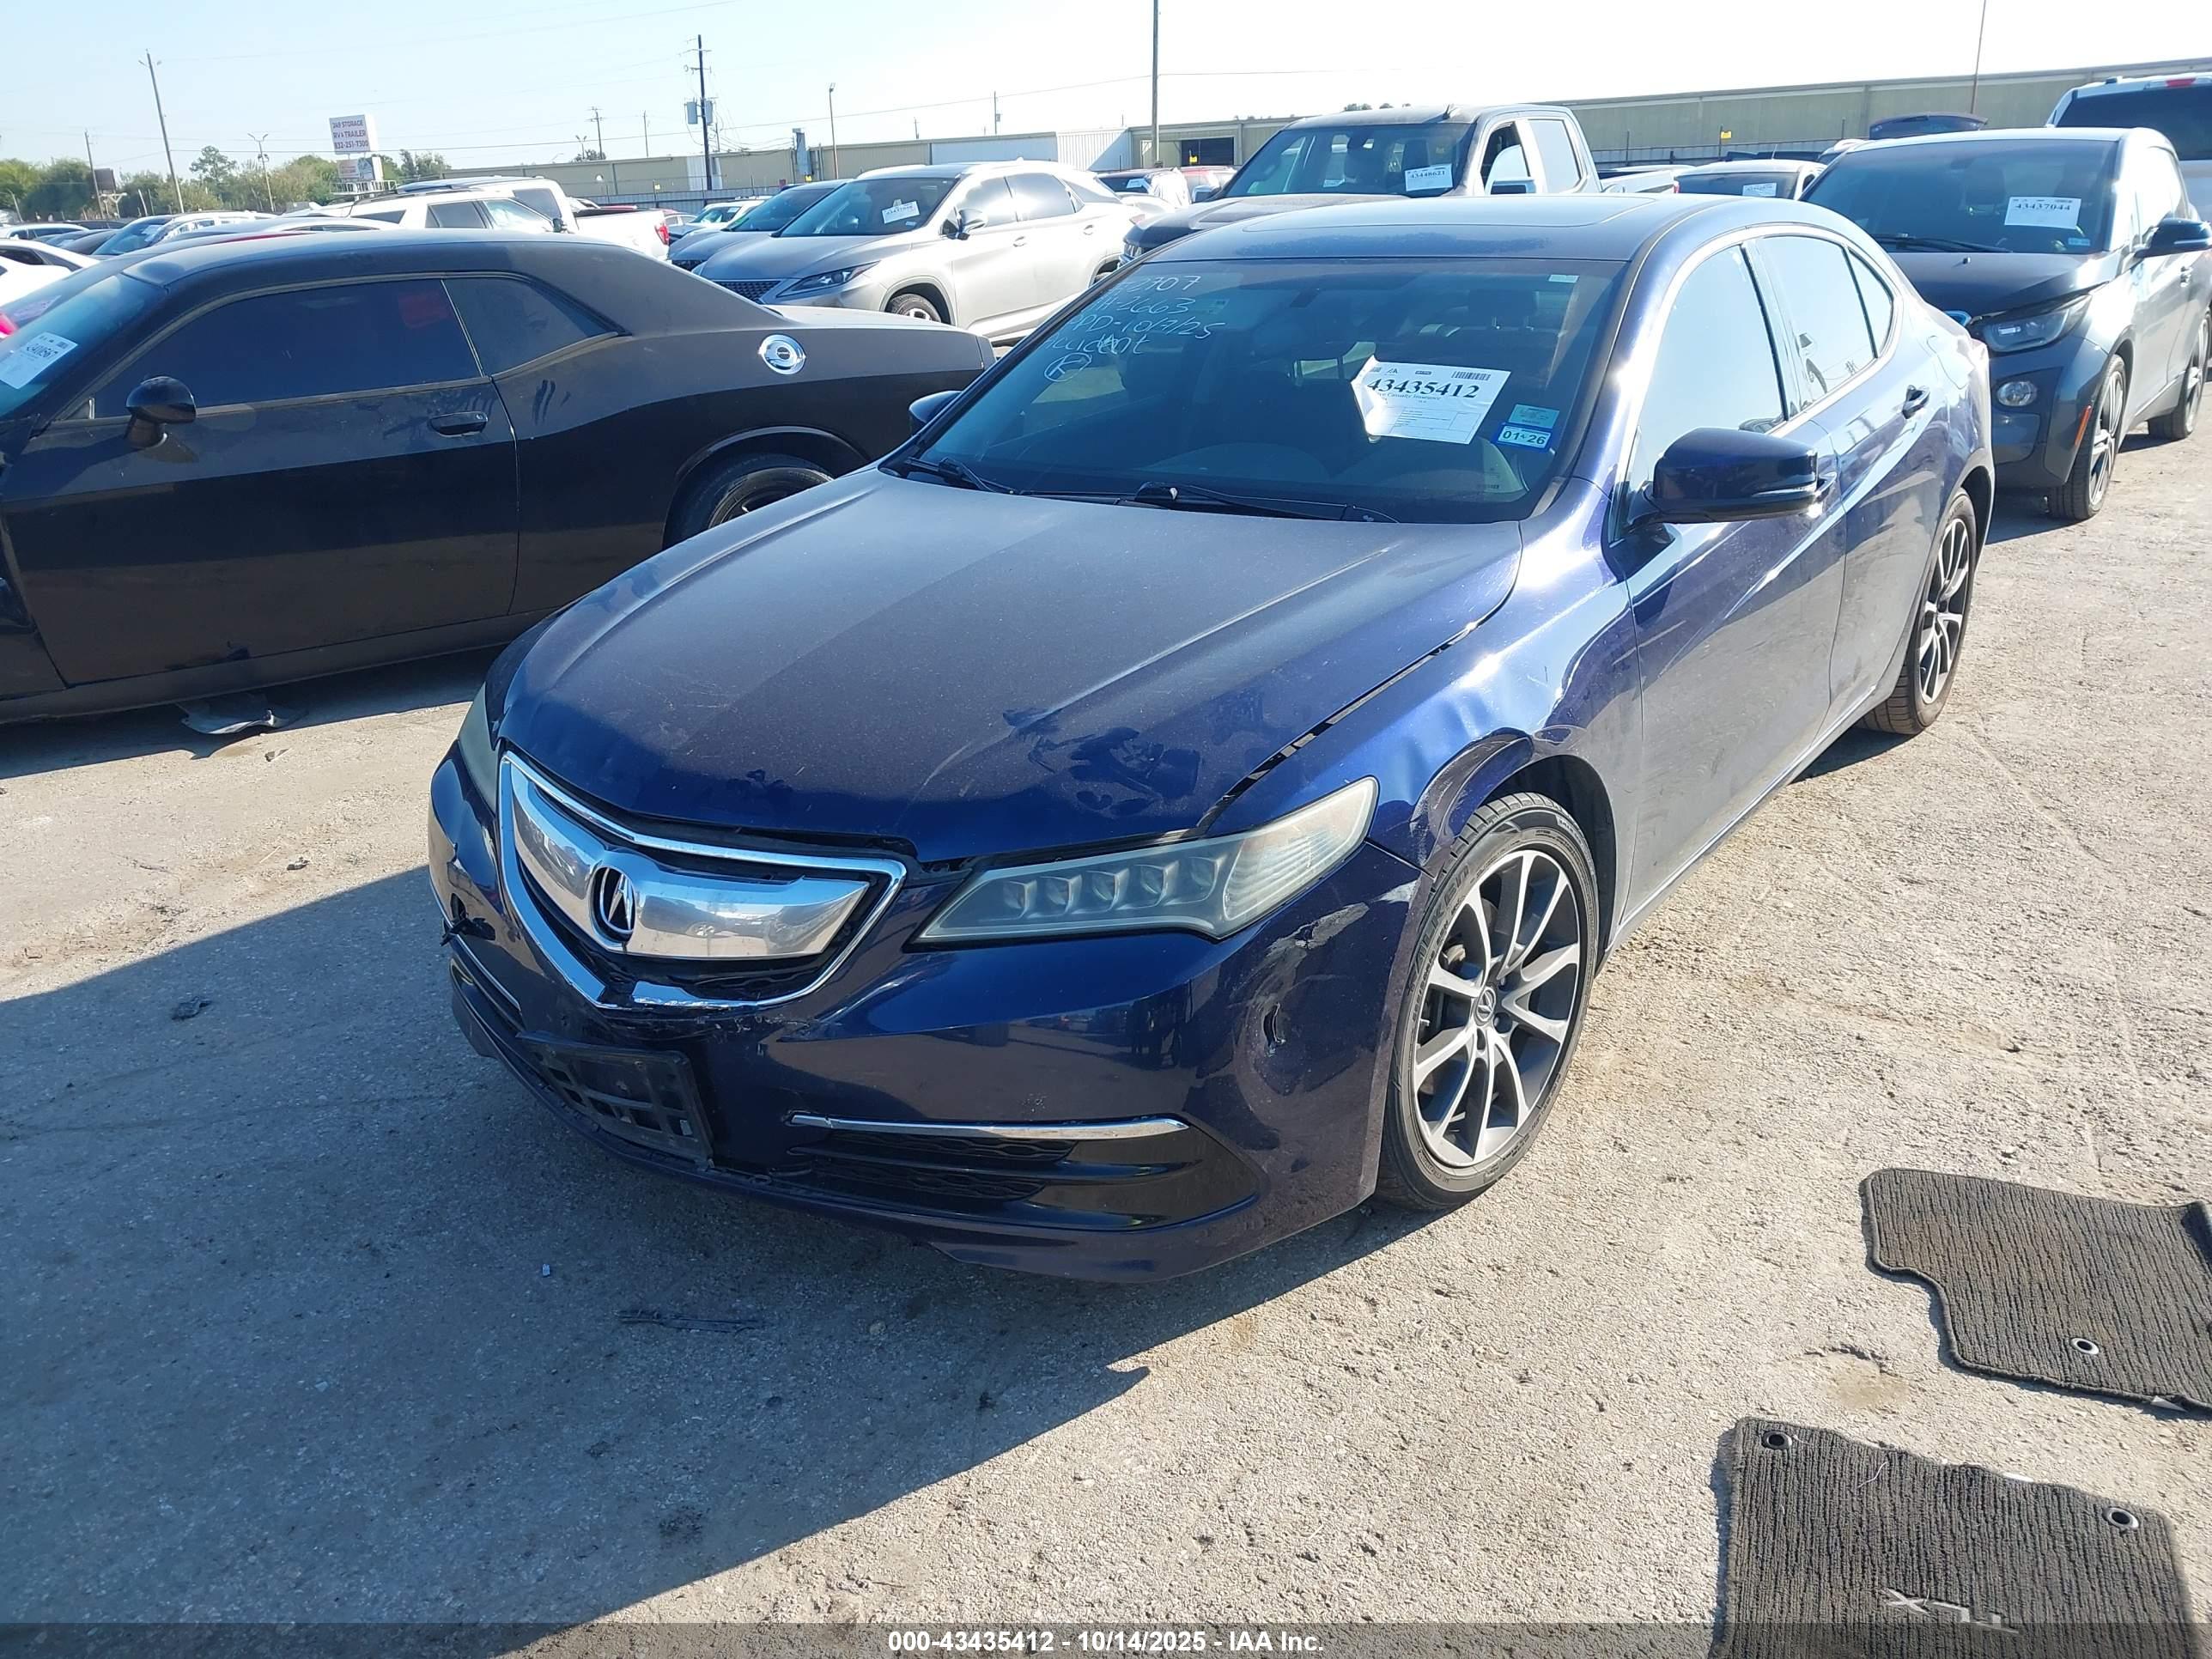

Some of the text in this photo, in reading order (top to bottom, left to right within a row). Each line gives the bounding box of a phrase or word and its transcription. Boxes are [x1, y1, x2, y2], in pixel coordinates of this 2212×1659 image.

[1367, 379, 1480, 398] 43435412
[1503, 430, 1546, 445] 01 26
